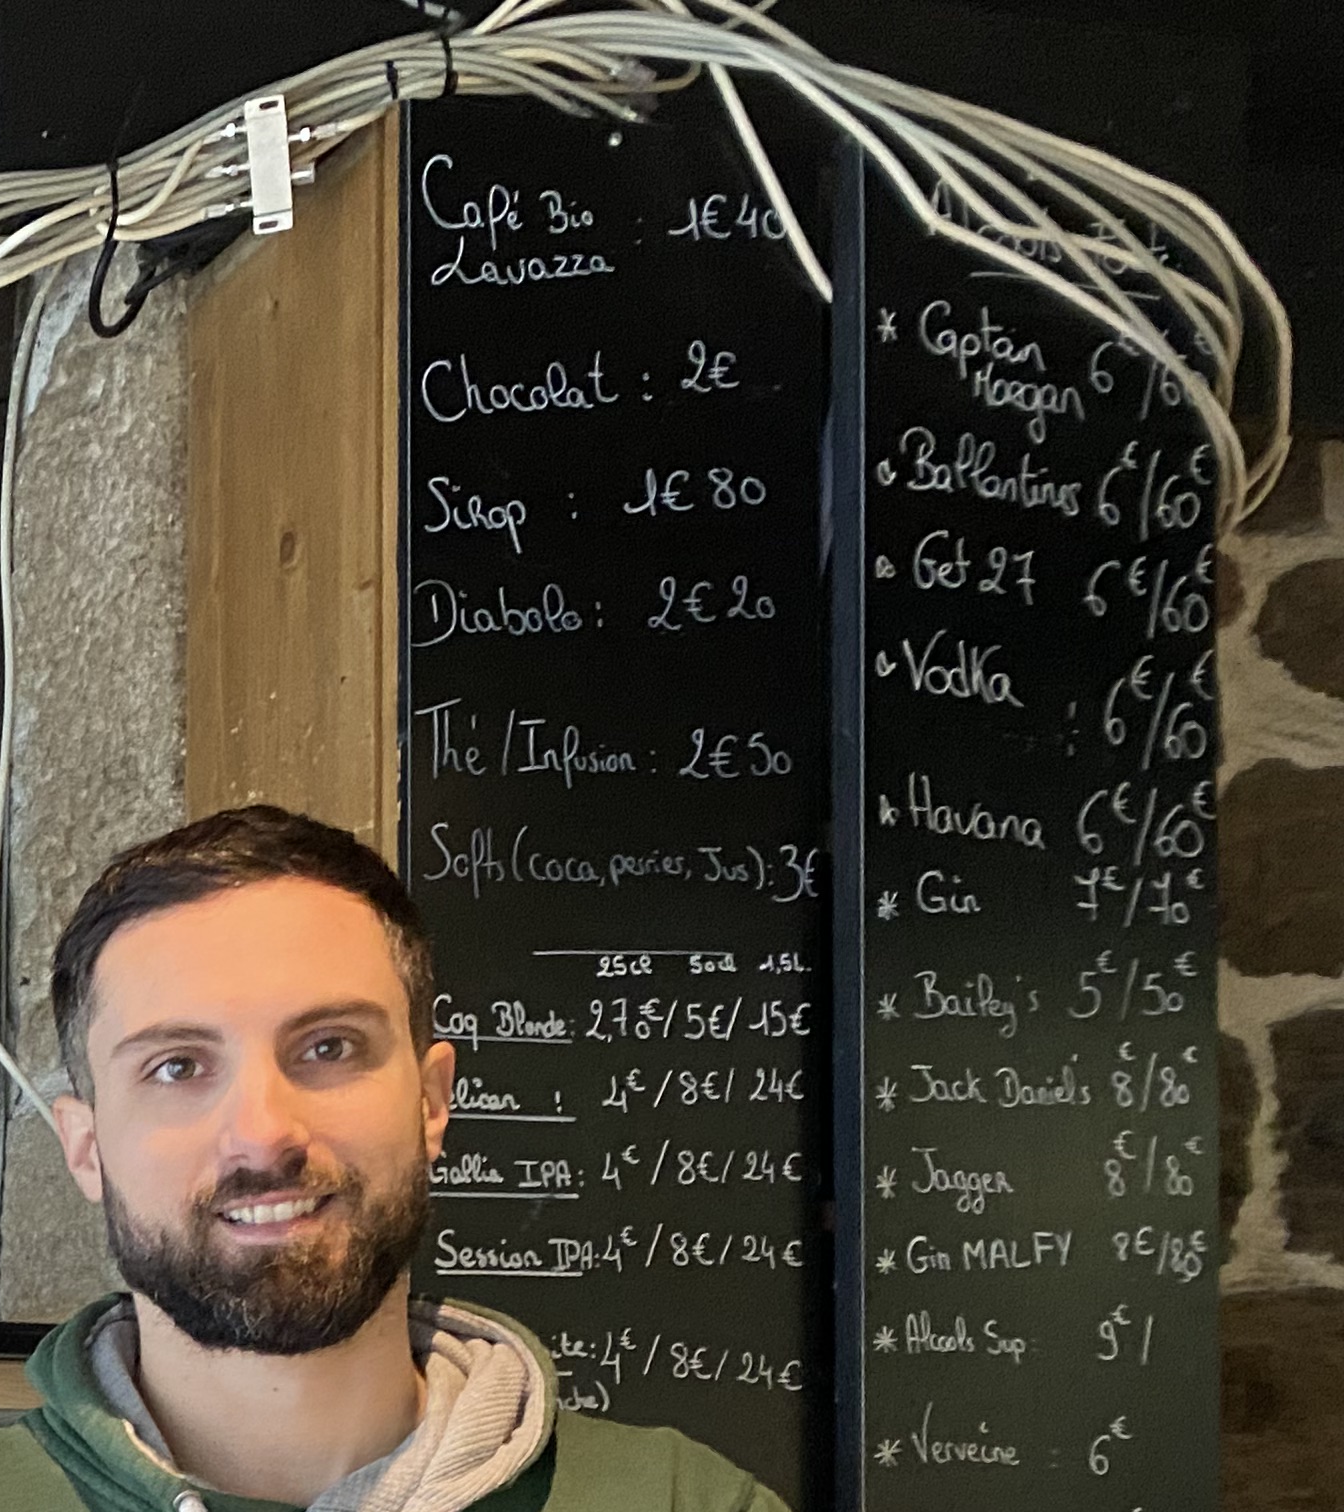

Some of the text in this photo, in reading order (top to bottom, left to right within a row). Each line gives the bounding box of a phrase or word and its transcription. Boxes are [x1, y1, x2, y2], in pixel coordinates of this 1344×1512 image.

[422, 154, 524, 251] Café
[540, 190, 595, 234] Bio
[431, 235, 615, 286] Lavazza
[422, 350, 619, 422] Chocolat
[914, 530, 972, 589] Get
[979, 546, 1036, 605] 27
[909, 772, 1046, 851] Havana
[917, 870, 981, 914] Gin
[911, 1065, 988, 1102] Jack
[434, 1229, 543, 1269] Session
[906, 1235, 951, 1274] Gin
[962, 1230, 1073, 1270] MALFY
